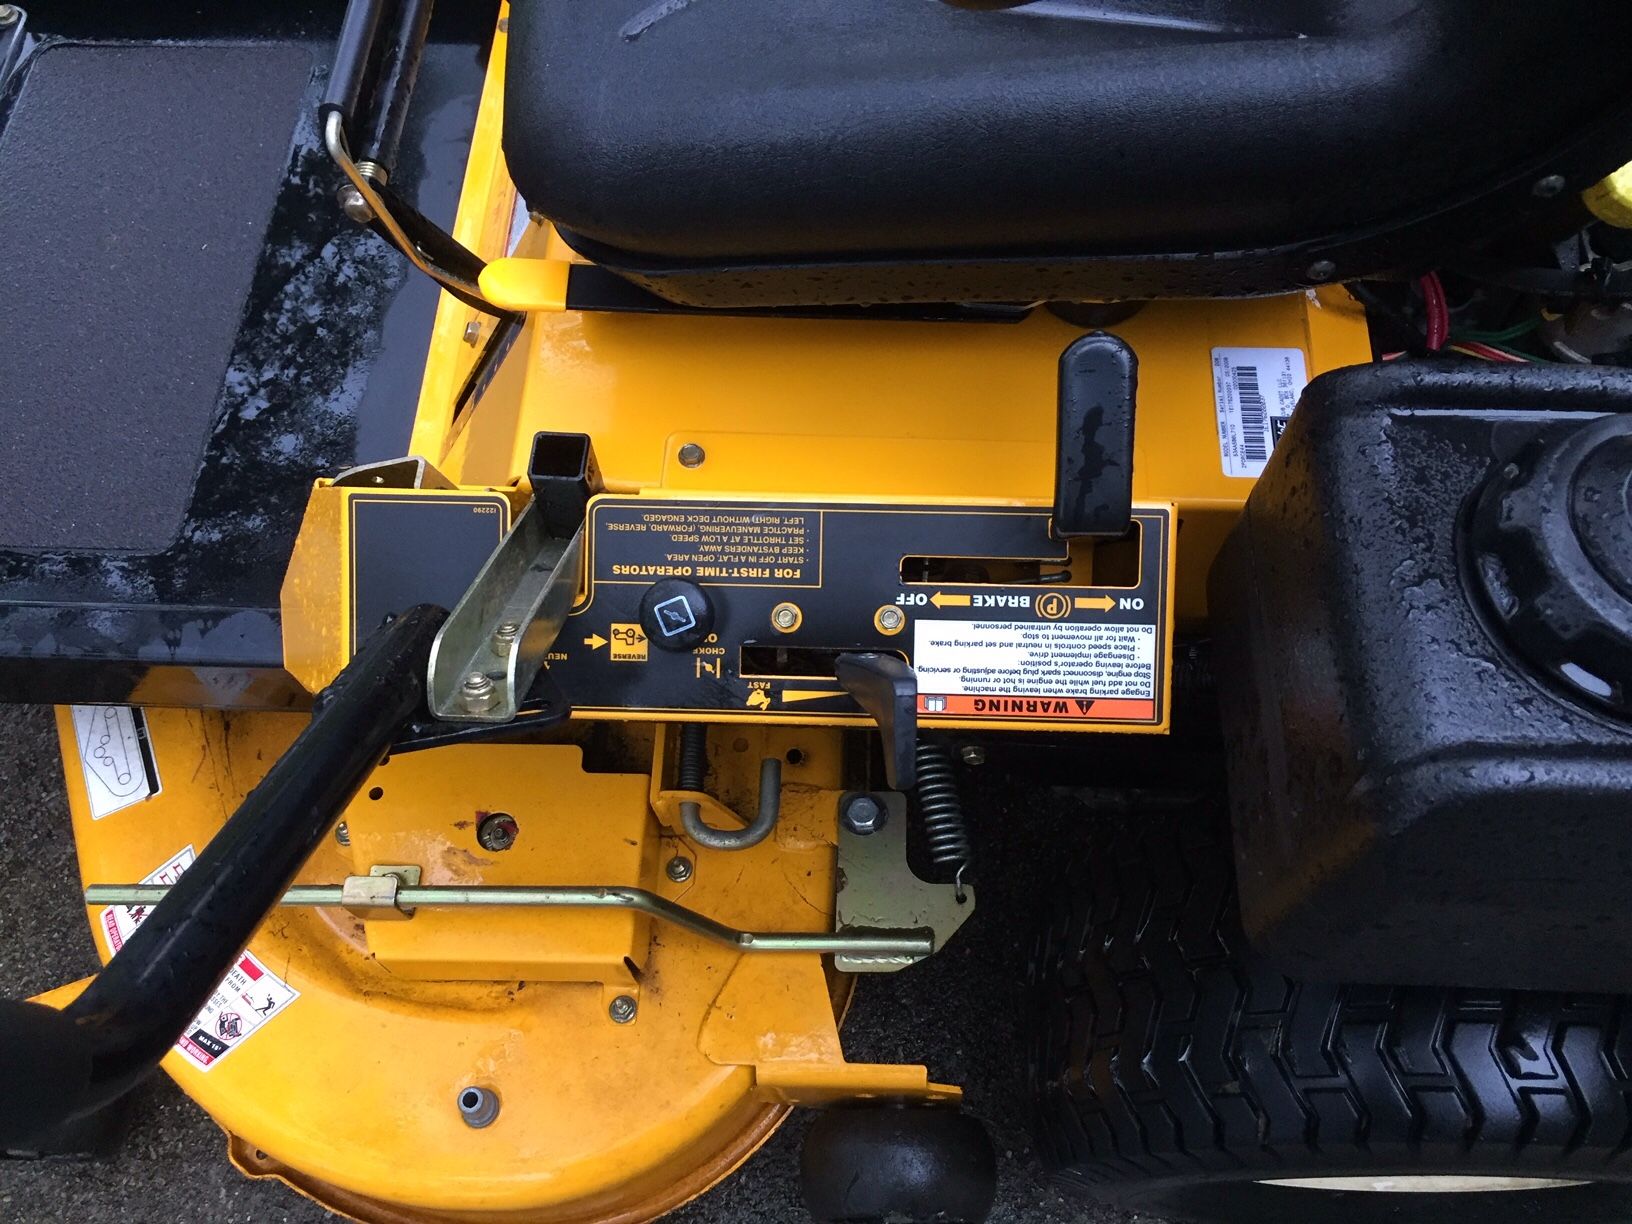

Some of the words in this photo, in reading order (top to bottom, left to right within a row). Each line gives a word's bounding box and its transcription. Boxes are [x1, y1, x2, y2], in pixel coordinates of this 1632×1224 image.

[752, 515, 780, 524] RIGHT)
[606, 523, 647, 531] REVERSE,
[649, 524, 696, 532] (FORWARD,
[697, 525, 761, 533] MANEUVERING,
[724, 545, 780, 554] BYSTANDERS
[612, 565, 692, 576] OPERATORS
[696, 567, 770, 578] FIRST-TIME
[774, 568, 801, 579] FOR
[895, 593, 928, 606] OFF
[972, 594, 1031, 607] BRAKE
[1119, 597, 1145, 610] ON
[971, 623, 1012, 631] personnel.
[1053, 624, 1063, 632] by
[1065, 624, 1102, 633] operation
[954, 640, 984, 648] parking
[1088, 641, 1112, 651] speed
[1050, 649, 1092, 659] implement
[1093, 650, 1136, 660] Disengage
[1017, 657, 1052, 667] position:
[1054, 658, 1094, 668] operator's
[1096, 661, 1124, 669] leaving
[915, 666, 952, 674] servicing.
[962, 667, 997, 675] adjusting
[1022, 666, 1040, 676] plug
[1040, 667, 1062, 676] spark
[1105, 668, 1133, 678] engine,
[1133, 668, 1153, 678] Stop
[959, 675, 991, 684] running.
[1026, 676, 1054, 685] engine
[747, 681, 771, 689] FAST
[1013, 684, 1041, 694] leaving
[1090, 686, 1120, 696] parking
[1121, 686, 1151, 696] Engage
[973, 699, 1070, 714] WARNING
[225, 977, 240, 992] FROM
[198, 1035, 212, 1047] MAX
